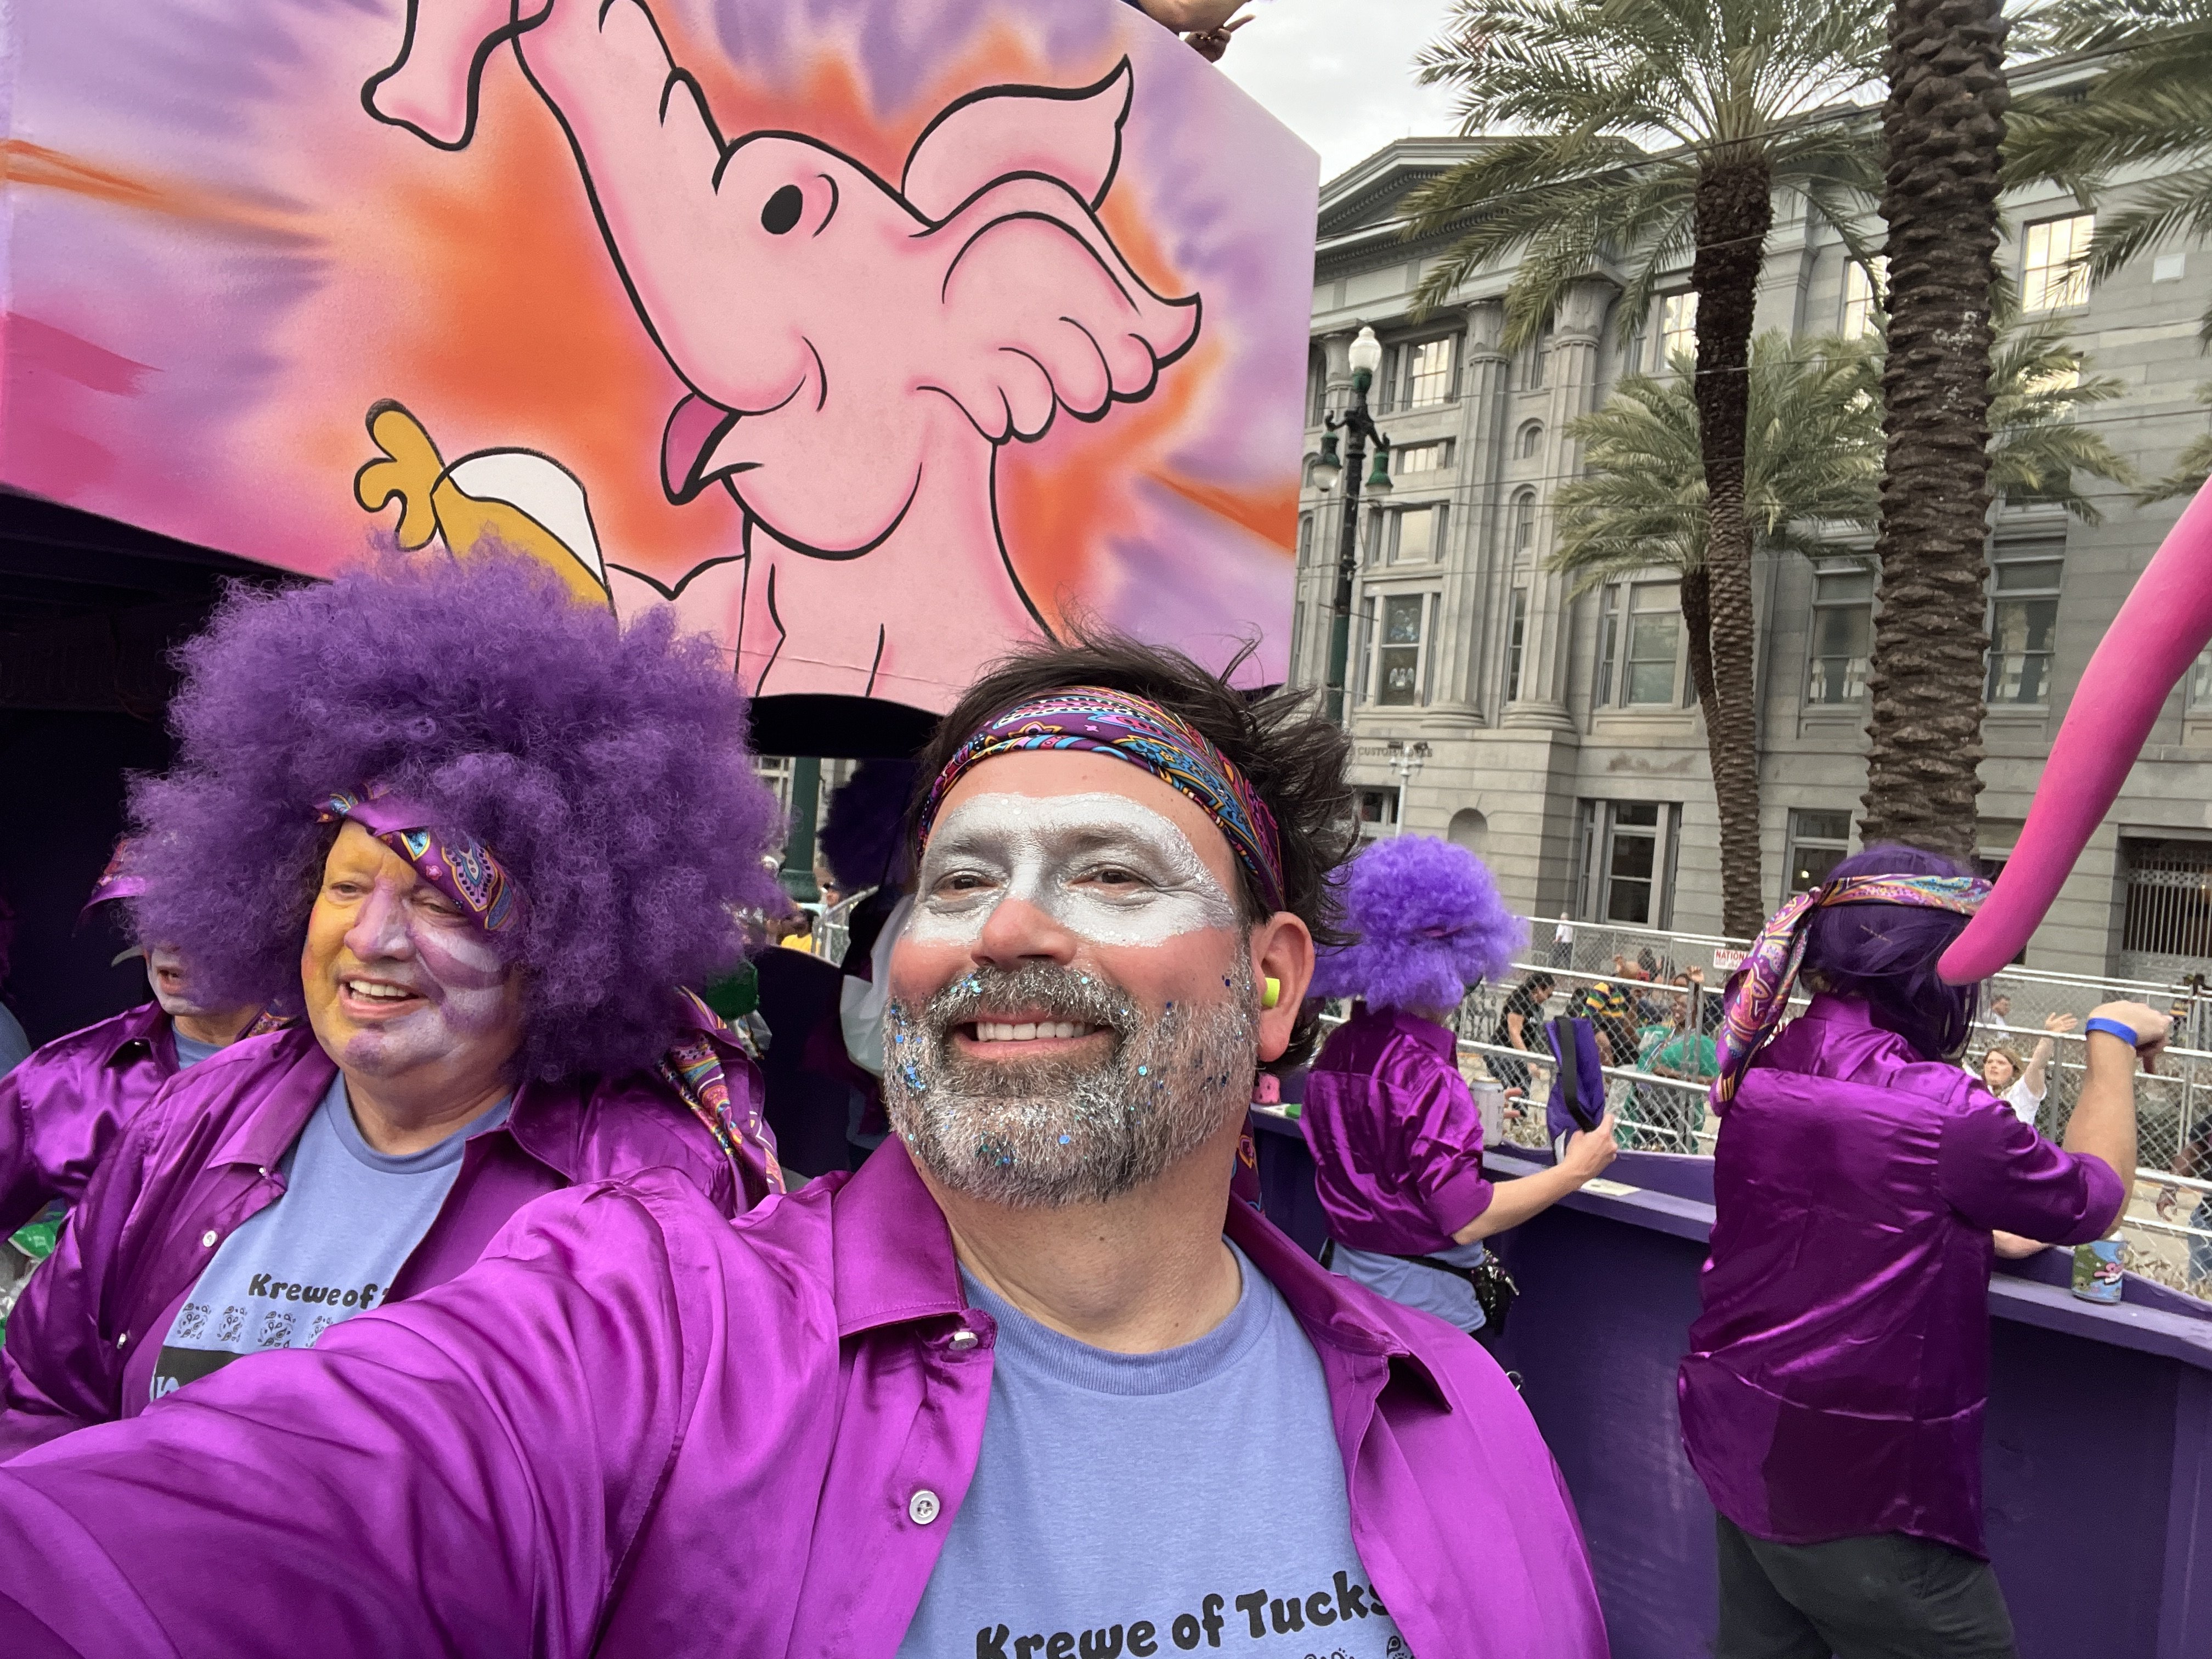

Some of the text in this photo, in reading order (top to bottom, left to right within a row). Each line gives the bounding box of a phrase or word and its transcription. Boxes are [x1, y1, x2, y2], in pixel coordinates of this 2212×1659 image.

[248, 1273, 379, 1310] Krewe of
[976, 1570, 1389, 1659] Krewe of Tucks
